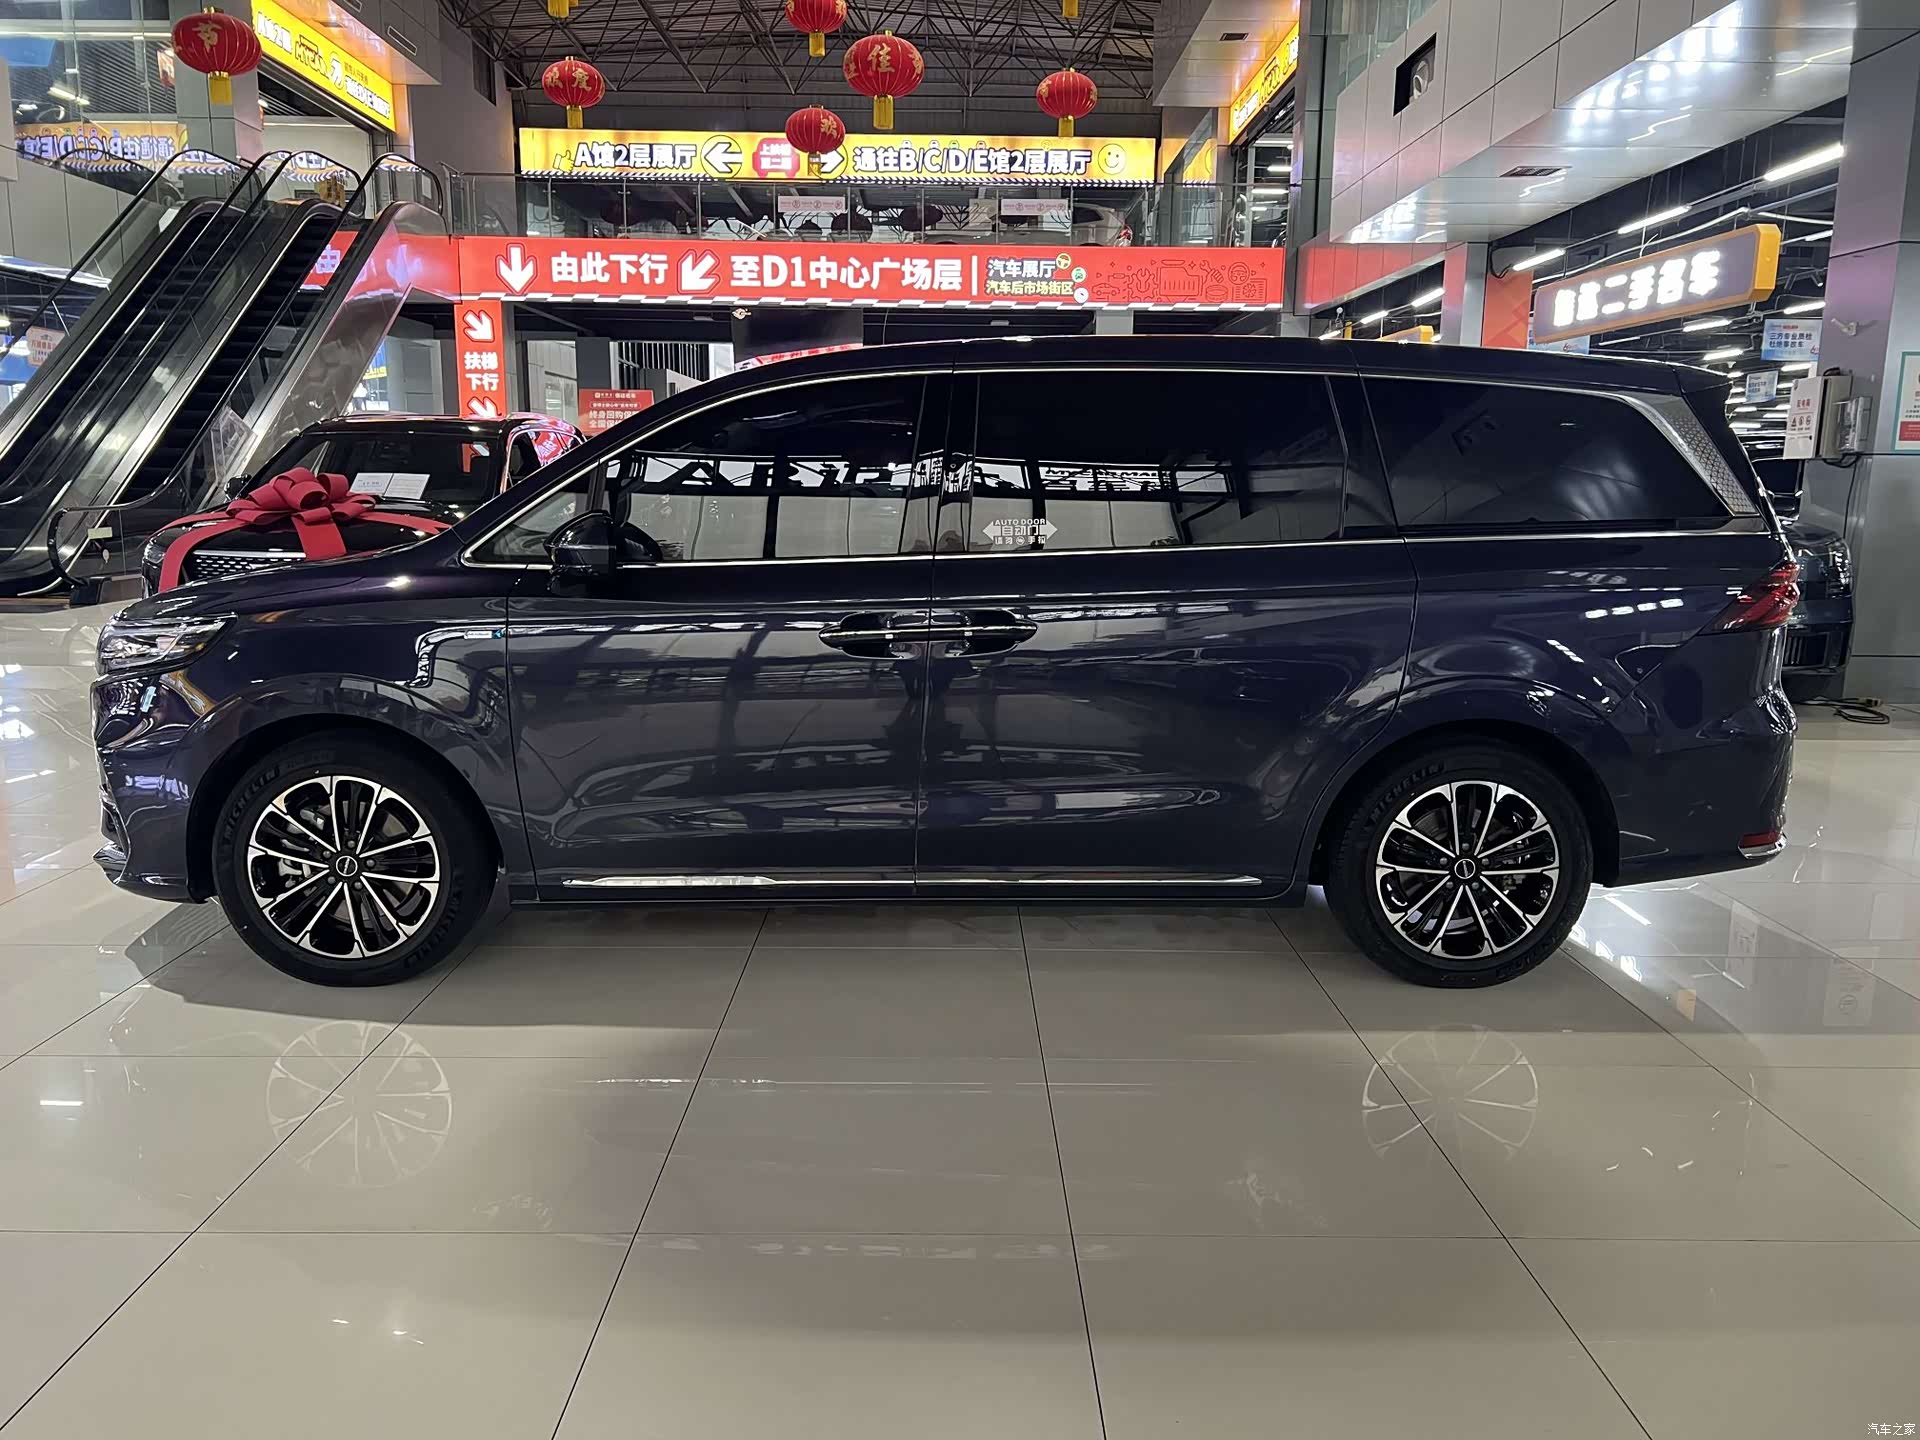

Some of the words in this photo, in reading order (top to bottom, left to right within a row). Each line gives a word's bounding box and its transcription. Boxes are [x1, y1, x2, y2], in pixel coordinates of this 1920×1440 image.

[867, 42, 895, 73] 佳
[574, 141, 698, 170] A馆2层展厅
[852, 145, 1092, 175] 通往B/C/D/E馆2层展厅
[550, 250, 669, 285] 由此下行
[729, 254, 963, 292] 至D1中心广场层
[987, 257, 1057, 279] 汽车展厅
[985, 280, 1076, 297] 汽车后市场街区
[463, 351, 499, 371] 扶梯
[465, 373, 499, 392] 下行
[1001, 525, 1039, 536] 自动门
[223, 765, 281, 841] MICHELIN
